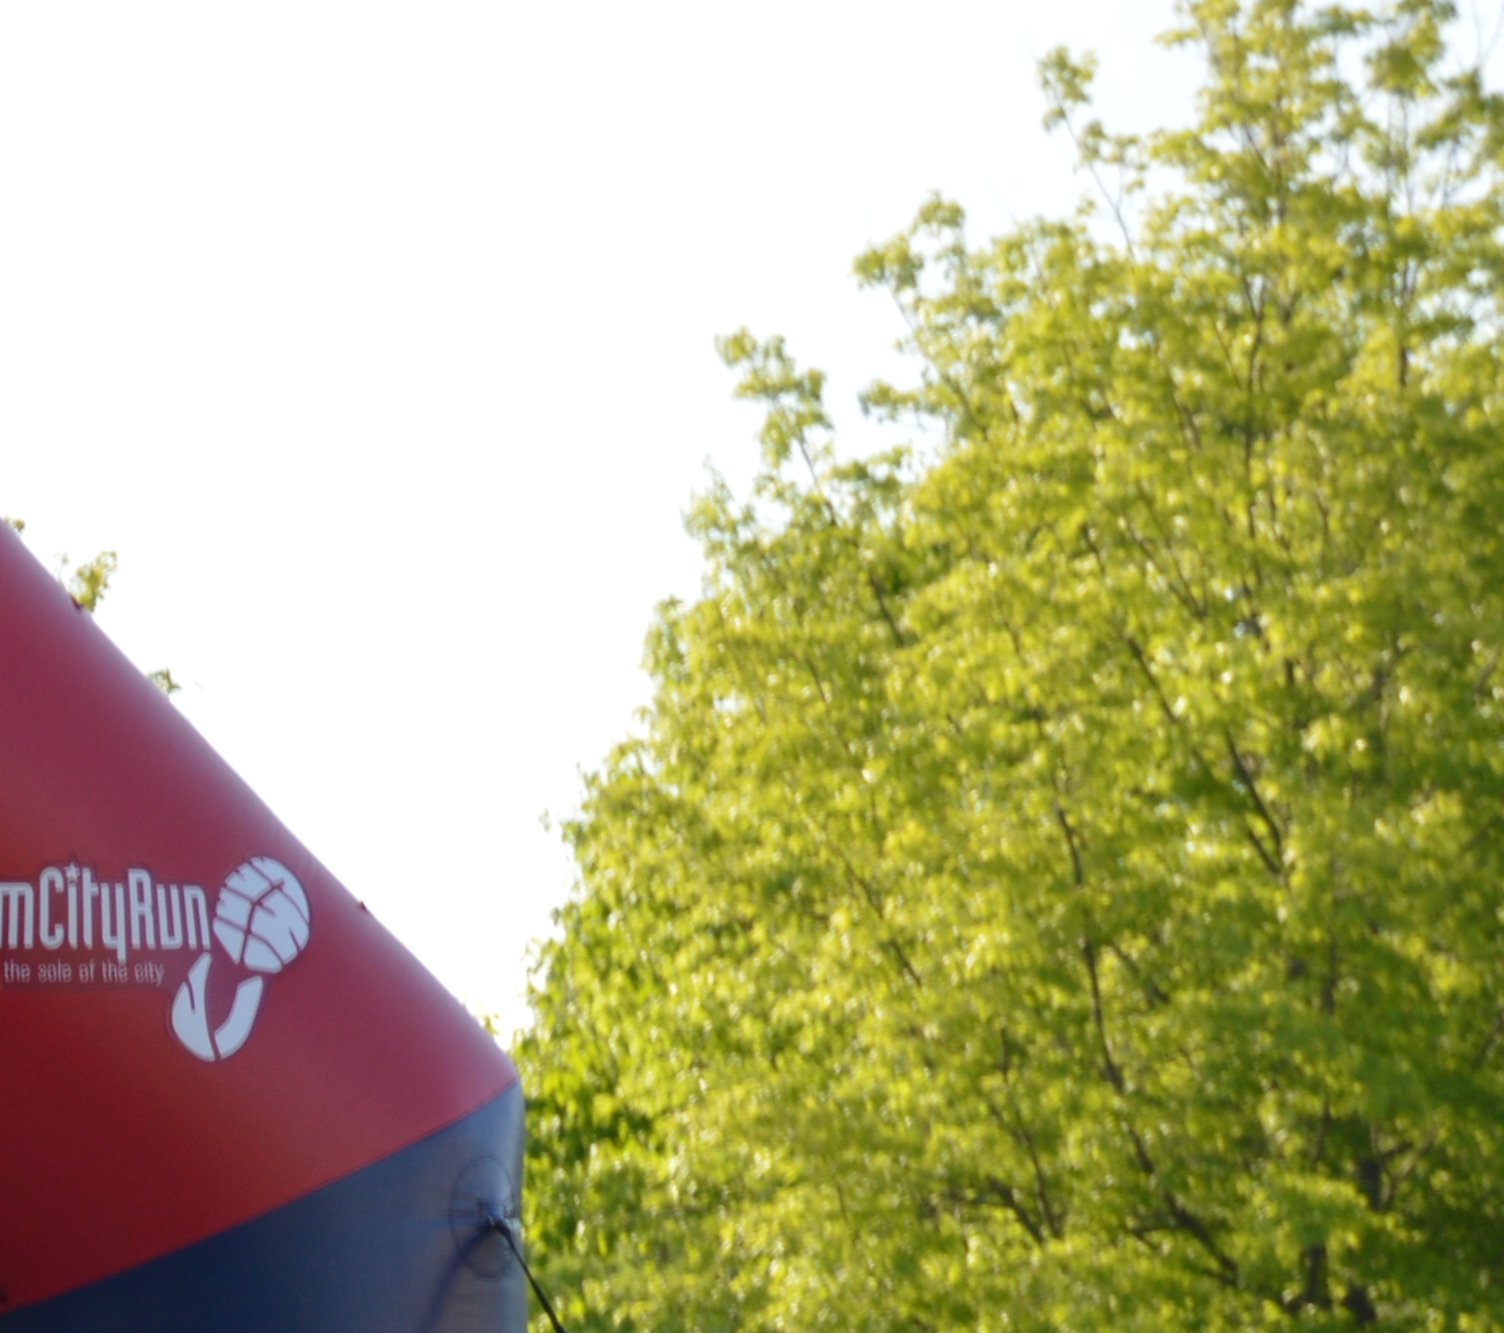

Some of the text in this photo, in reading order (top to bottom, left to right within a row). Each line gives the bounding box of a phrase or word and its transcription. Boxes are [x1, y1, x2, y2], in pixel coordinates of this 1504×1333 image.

[3, 959, 165, 987] the sole of the city
